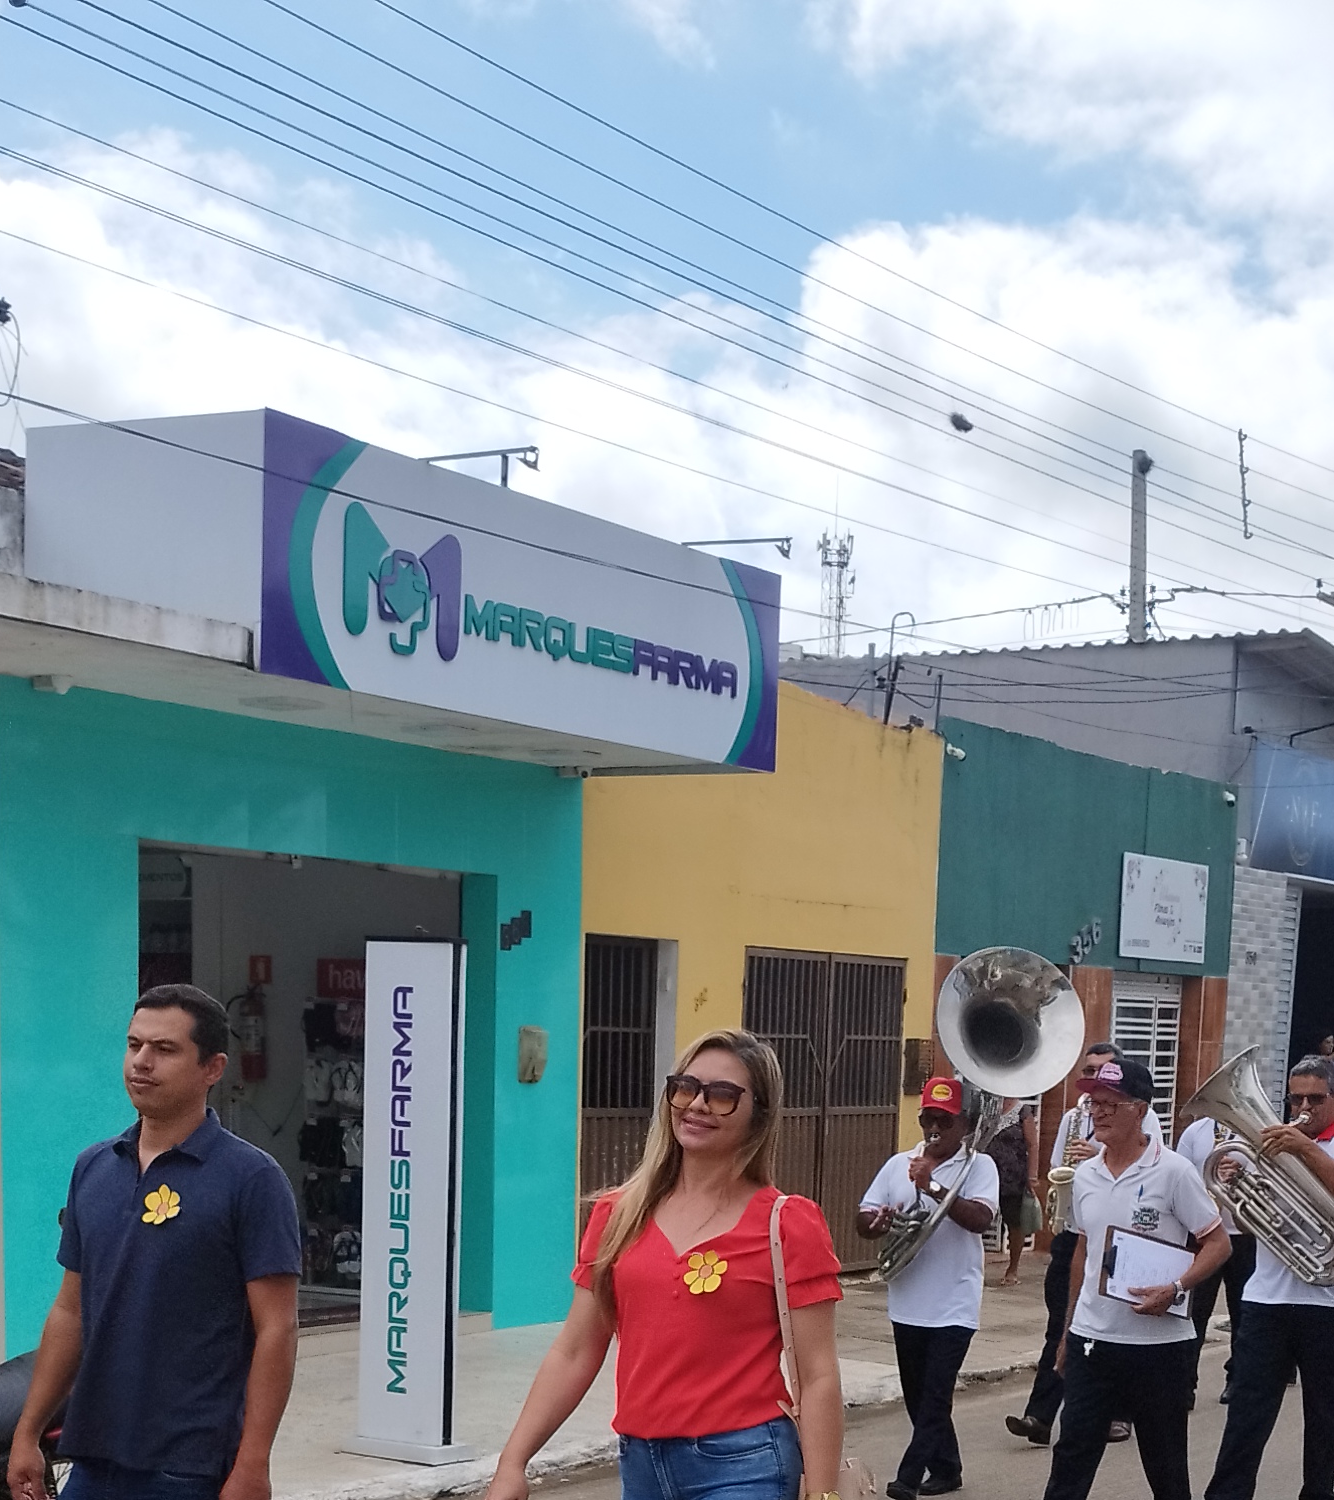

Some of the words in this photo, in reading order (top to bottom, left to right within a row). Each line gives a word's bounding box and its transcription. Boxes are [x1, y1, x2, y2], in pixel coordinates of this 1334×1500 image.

[464, 593, 738, 699] MARQUESFARMA
[1069, 918, 1103, 965] 356
[386, 985, 415, 1395] MARQUESFARMA
